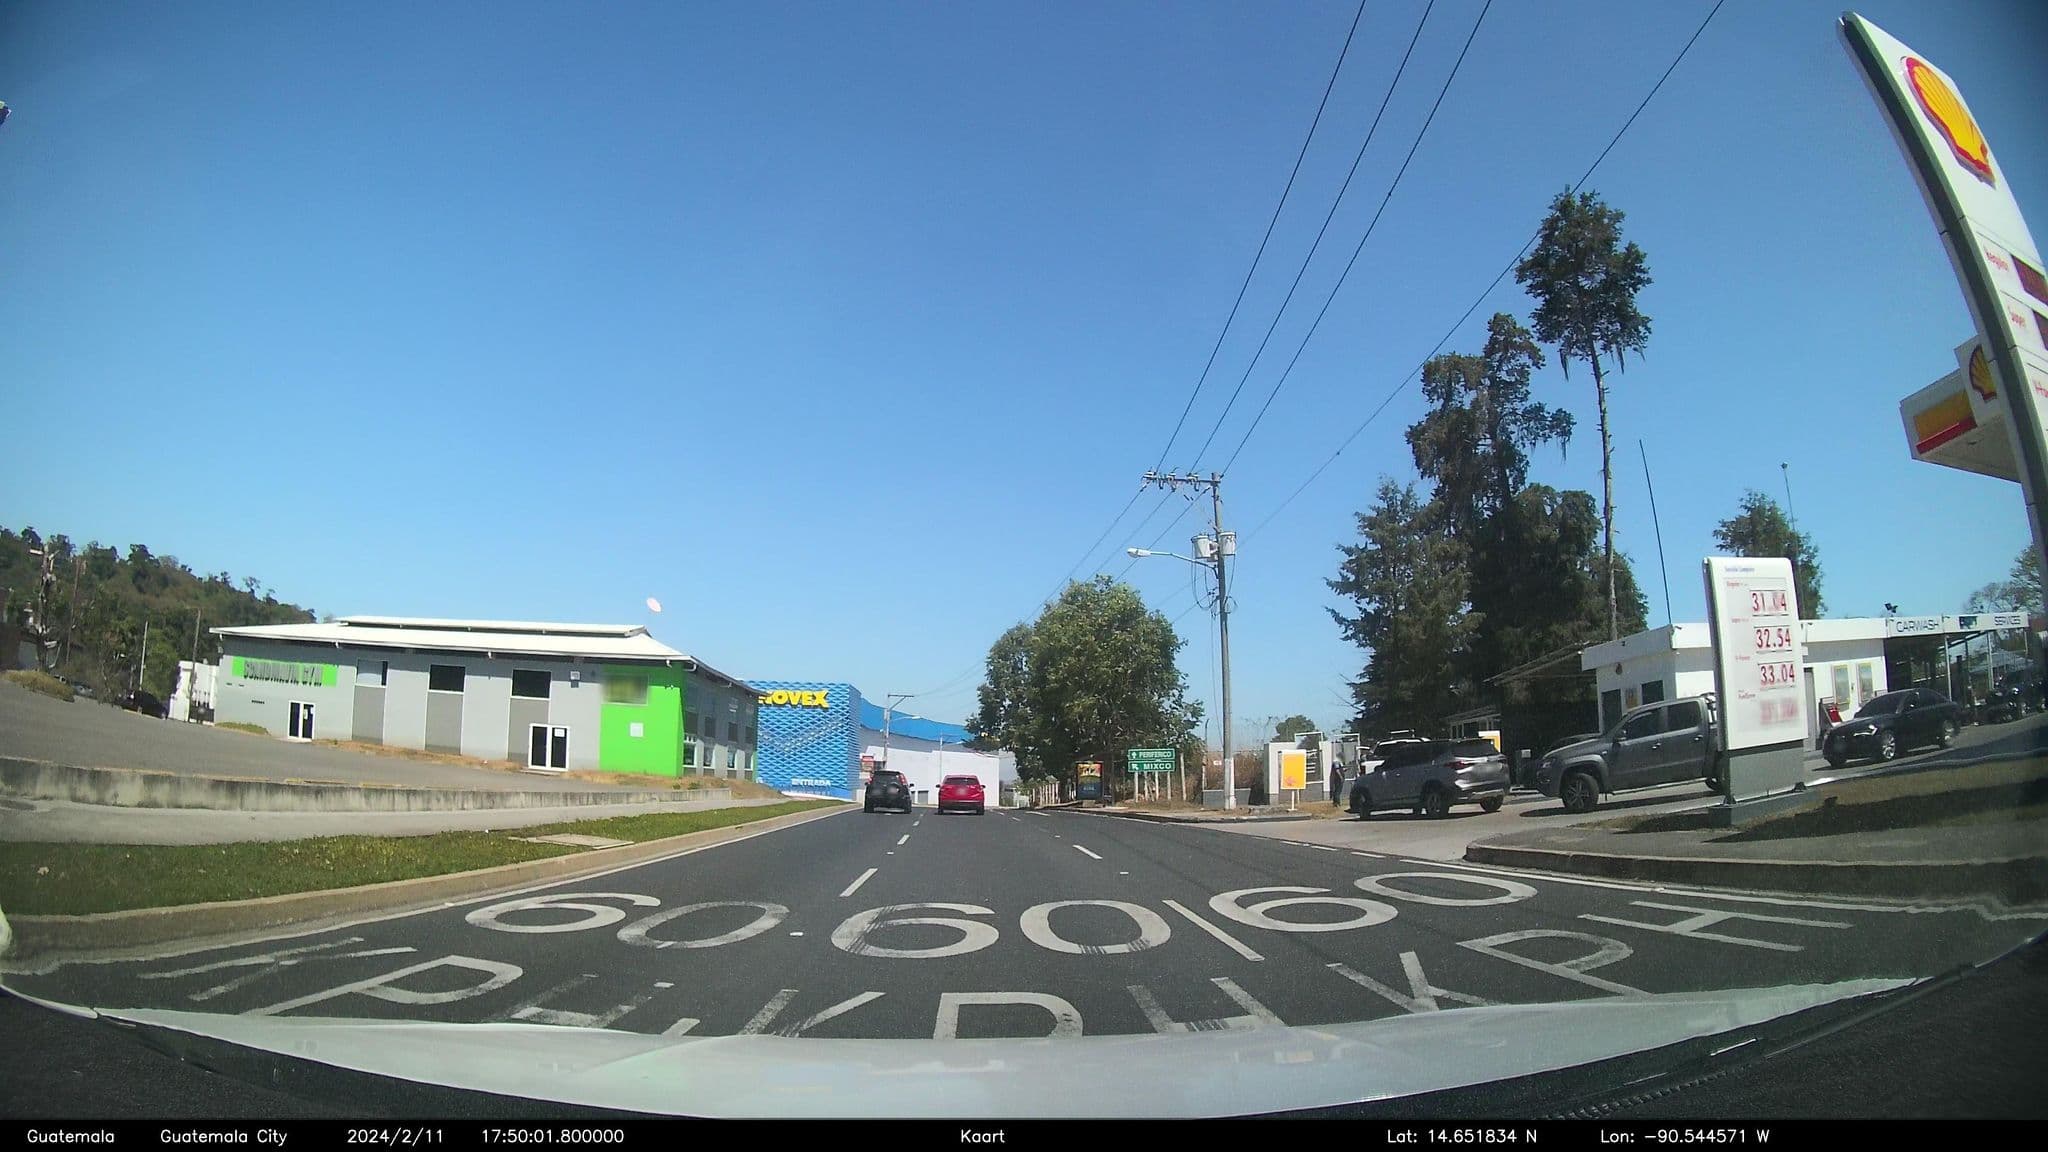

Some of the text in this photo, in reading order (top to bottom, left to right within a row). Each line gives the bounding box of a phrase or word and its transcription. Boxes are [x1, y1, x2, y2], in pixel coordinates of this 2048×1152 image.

[1756, 628, 1792, 649] 32.54
[1896, 619, 1939, 633] CARWASH
[1760, 663, 1795, 685] 33.04
[465, 892, 790, 949] 60
[1208, 872, 1538, 932] 60
[831, 899, 1172, 959] 60
